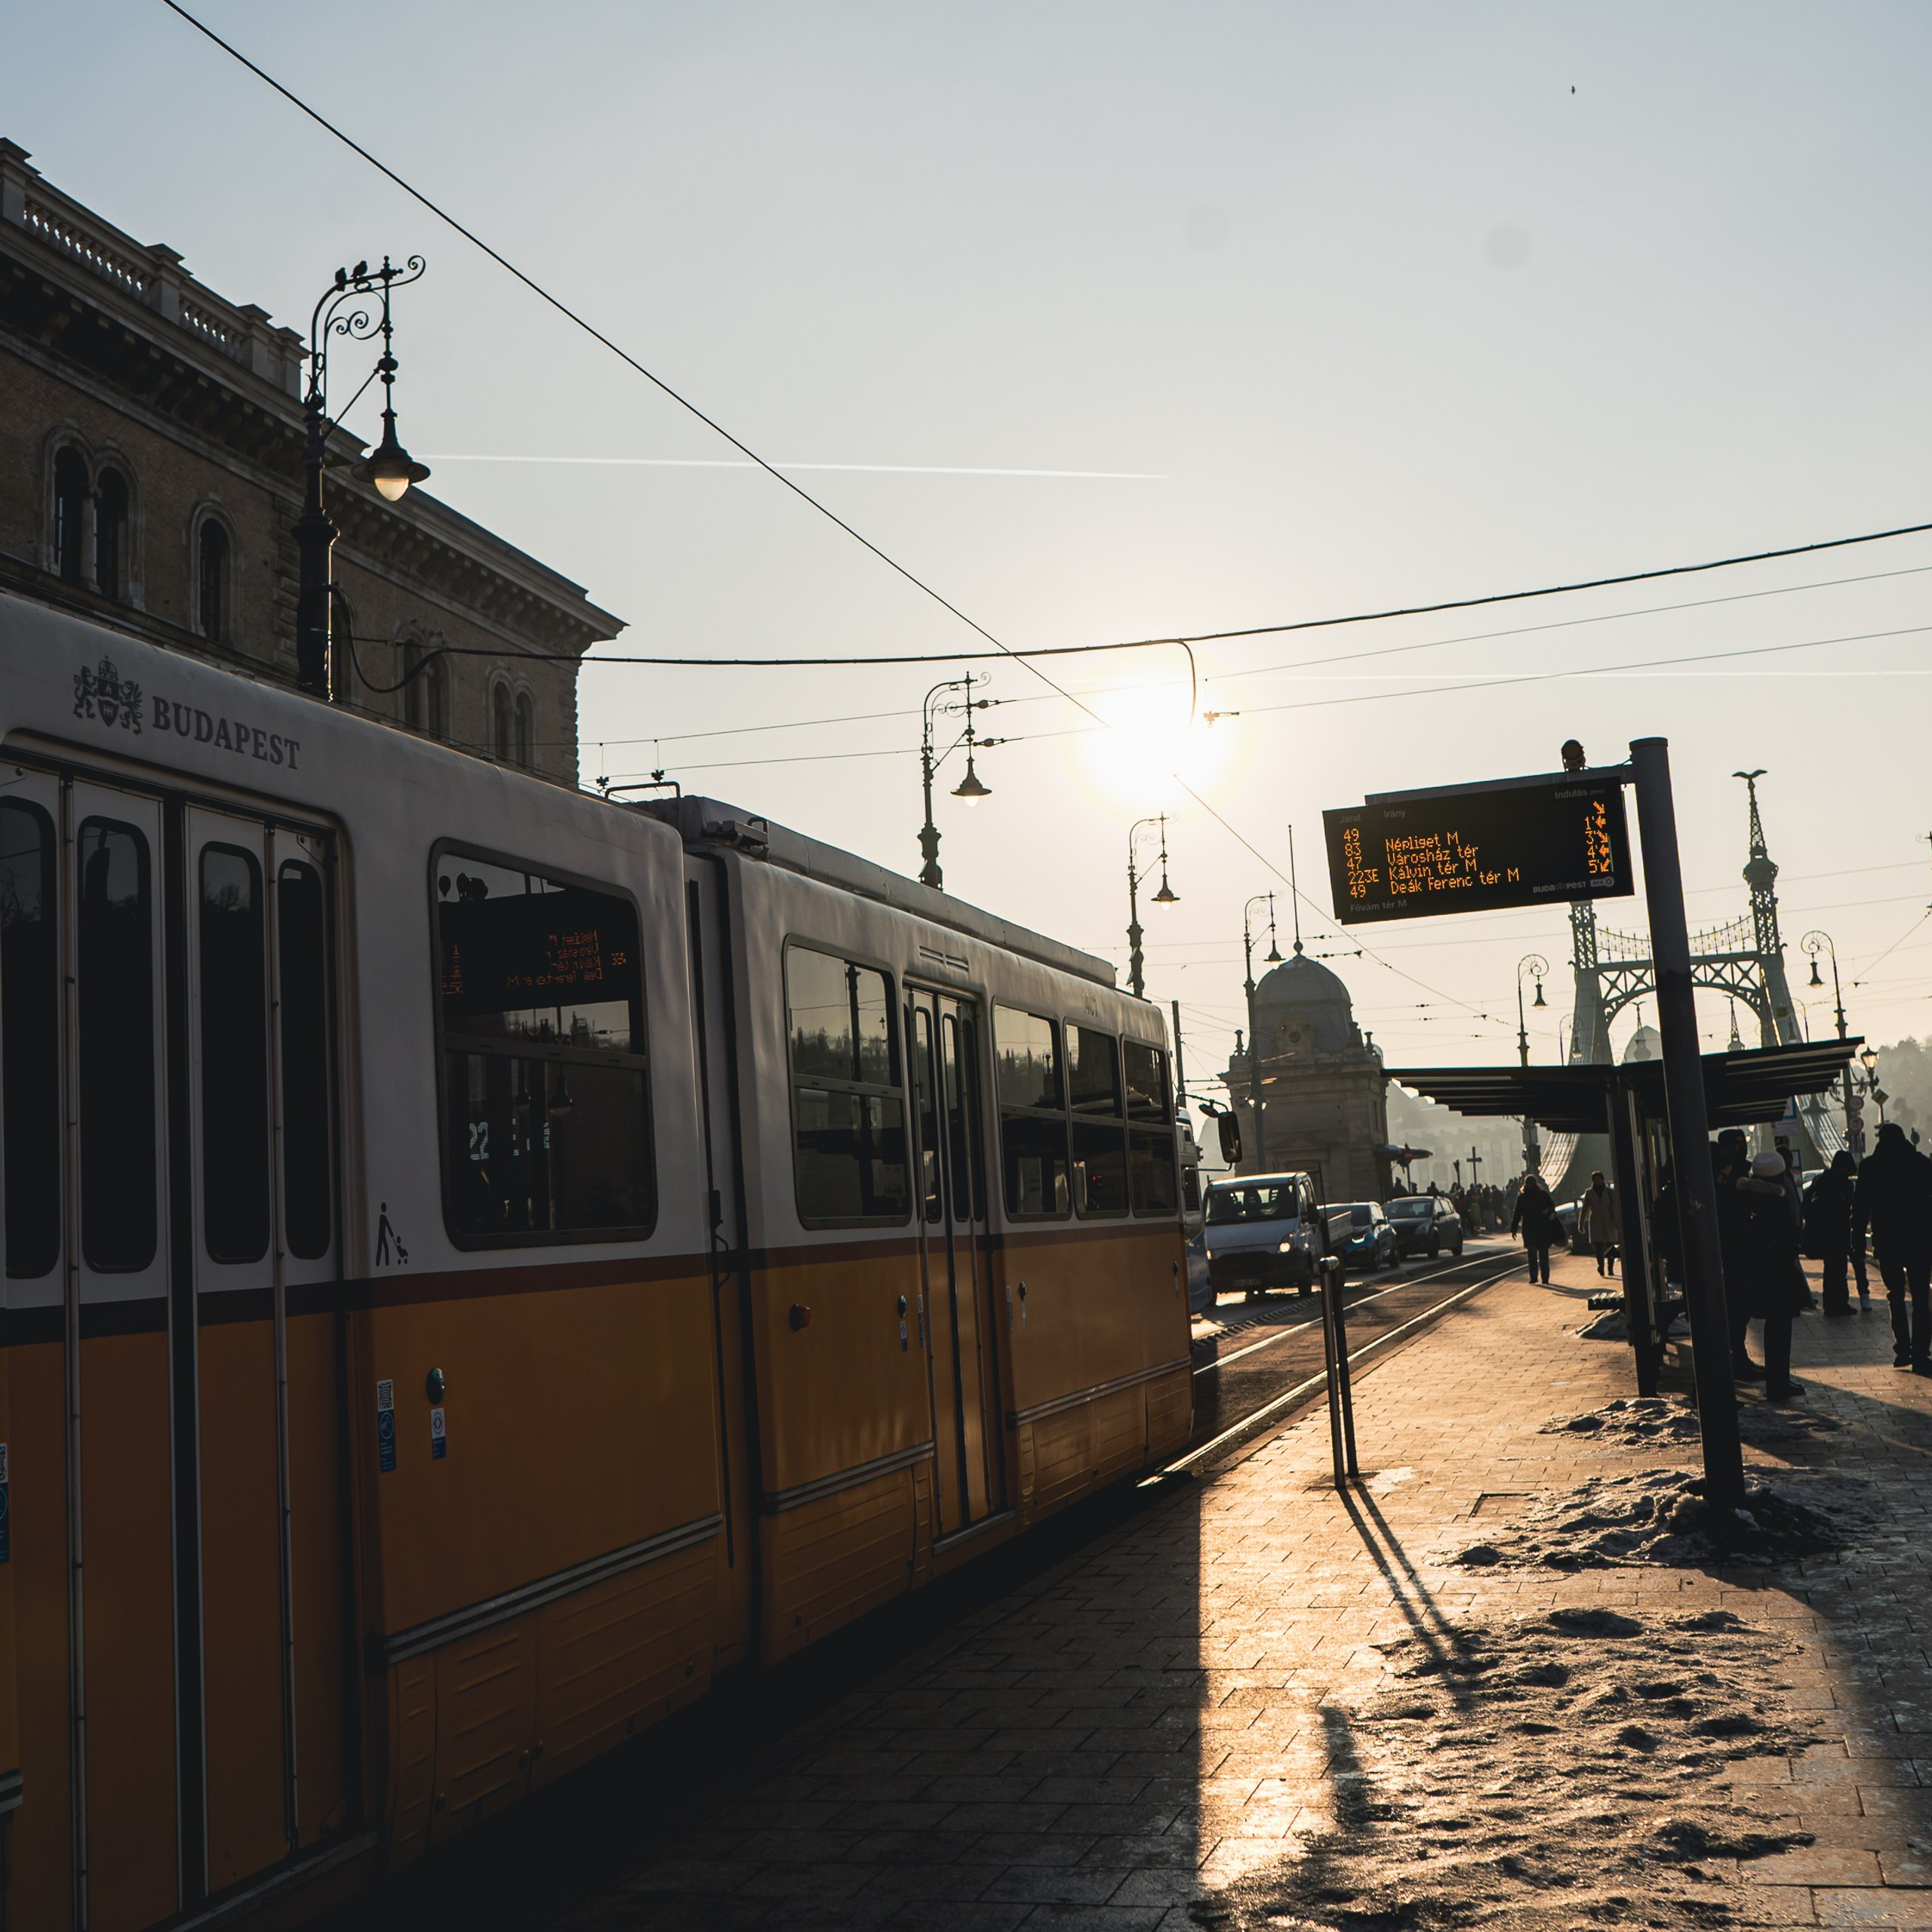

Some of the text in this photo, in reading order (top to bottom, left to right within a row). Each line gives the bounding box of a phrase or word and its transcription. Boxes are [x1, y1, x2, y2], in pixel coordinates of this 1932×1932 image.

[152, 695, 300, 770] BUDAPEST
[1383, 809, 1406, 819] Irány
[1555, 788, 1588, 799] Indulás
[1343, 828, 1360, 842] 49
[1345, 842, 1362, 857] 83
[1386, 833, 1441, 852] Népliget
[1447, 831, 1459, 845] M
[1346, 856, 1363, 870] 47
[1387, 848, 1451, 866] Városház
[1457, 844, 1478, 859] tér
[1348, 869, 1380, 885] 223E
[1389, 863, 1432, 881] Kálvin
[1437, 860, 1459, 875] tér
[1465, 858, 1477, 872] M
[1350, 884, 1366, 899] 49
[1390, 878, 1423, 895] Deák
[1428, 875, 1472, 891] Ferenc
[1479, 870, 1501, 885] tér
[1507, 867, 1520, 882] M
[1350, 899, 1407, 912] Fővám tér M
